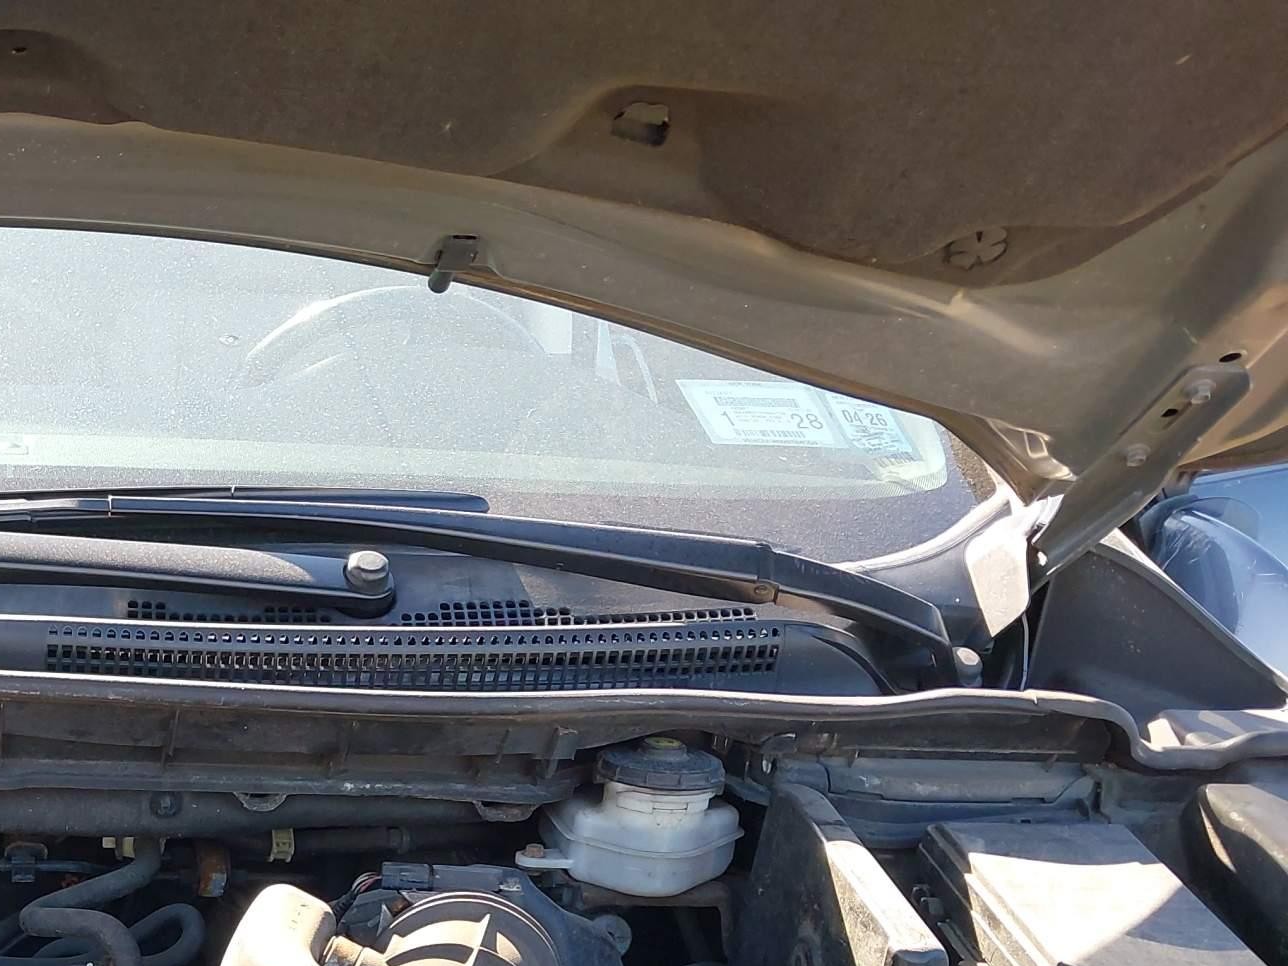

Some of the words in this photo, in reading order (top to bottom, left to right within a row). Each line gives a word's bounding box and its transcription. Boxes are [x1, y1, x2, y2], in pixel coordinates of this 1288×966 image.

[789, 413, 824, 430] 28
[840, 408, 863, 424] 04
[865, 412, 888, 427] 26
